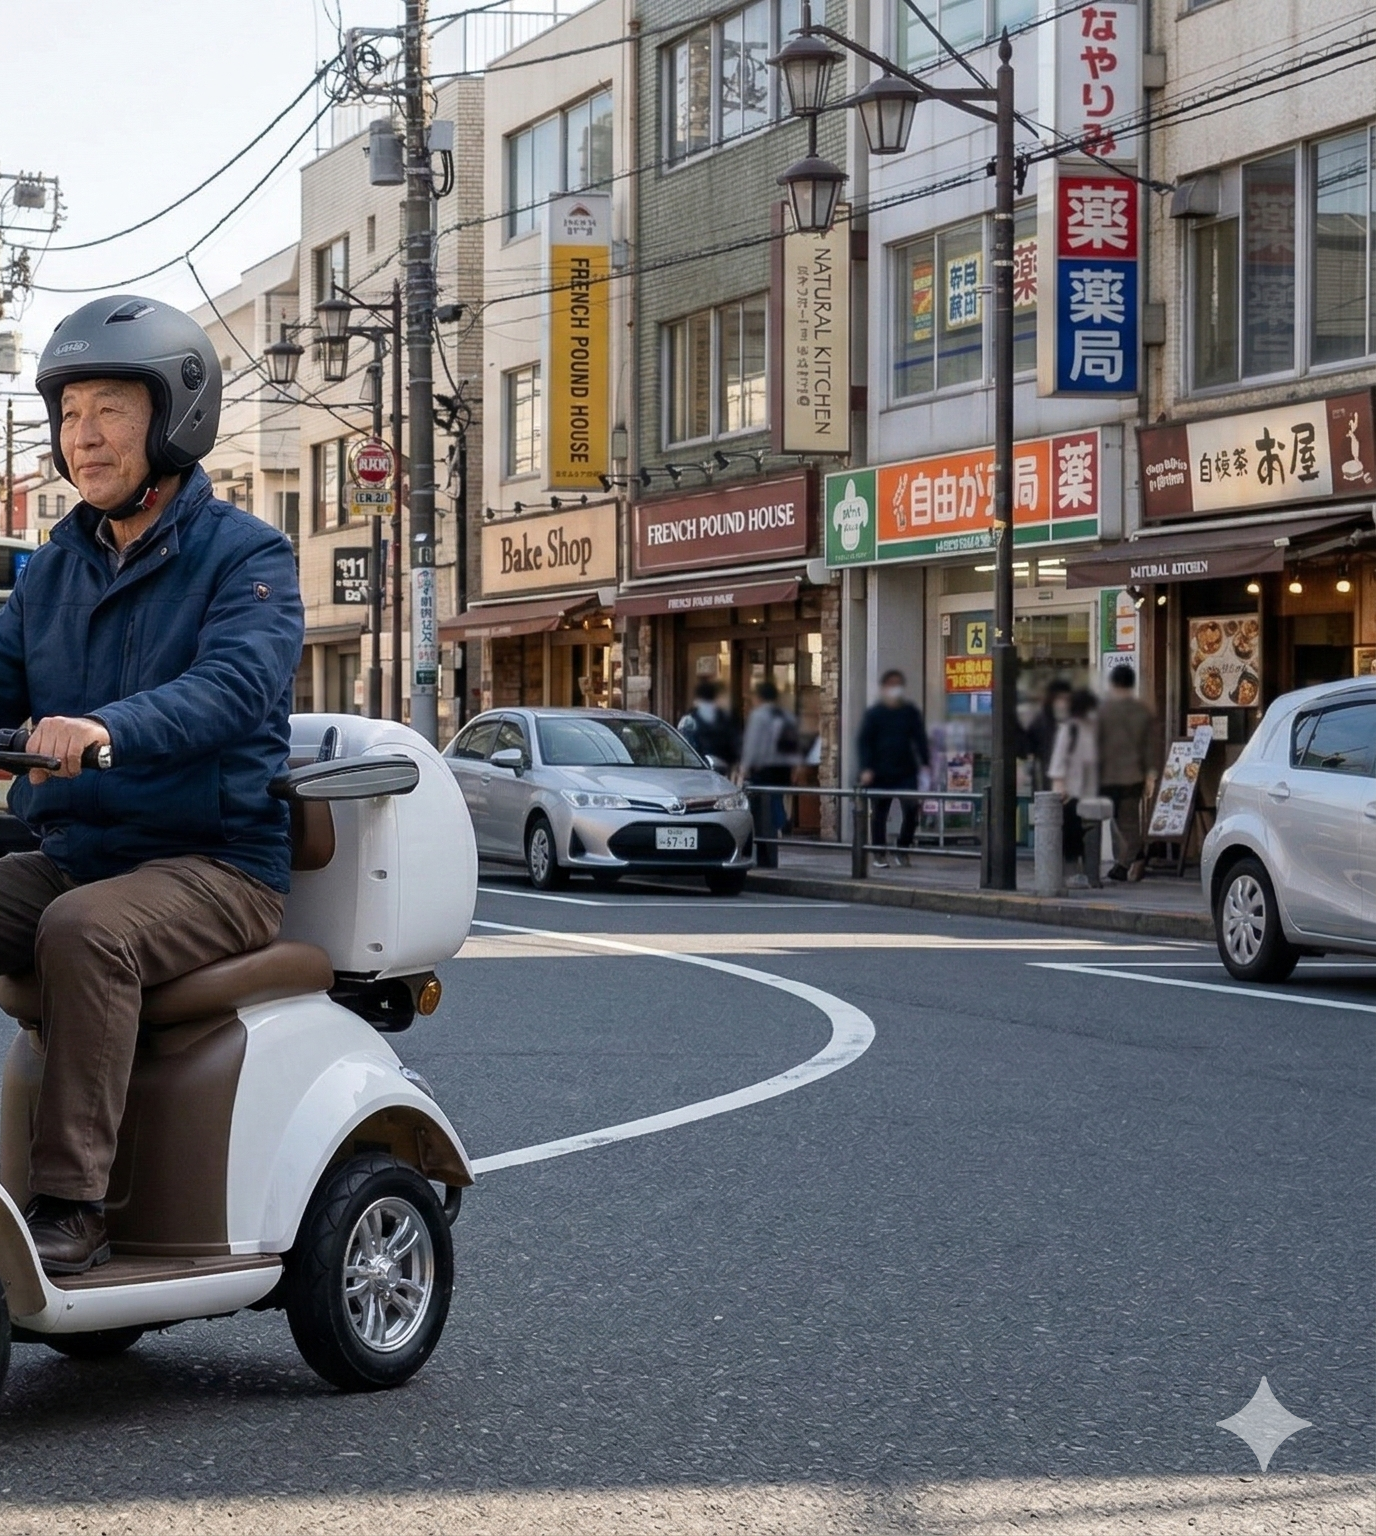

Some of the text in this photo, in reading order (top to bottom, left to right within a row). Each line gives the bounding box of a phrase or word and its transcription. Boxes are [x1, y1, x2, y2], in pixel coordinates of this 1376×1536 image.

[1067, 185, 1129, 249] 薬
[570, 257, 590, 329] FRENCH
[814, 248, 832, 435] NATURAL KITCHEN
[1069, 268, 1125, 383] 薬局
[570, 336, 590, 398] POUND
[570, 405, 590, 463] HOUSE
[1057, 440, 1093, 509] 薬
[500, 526, 593, 576] Bake Shop
[647, 503, 795, 546] FRENCH POUND HOUSE
